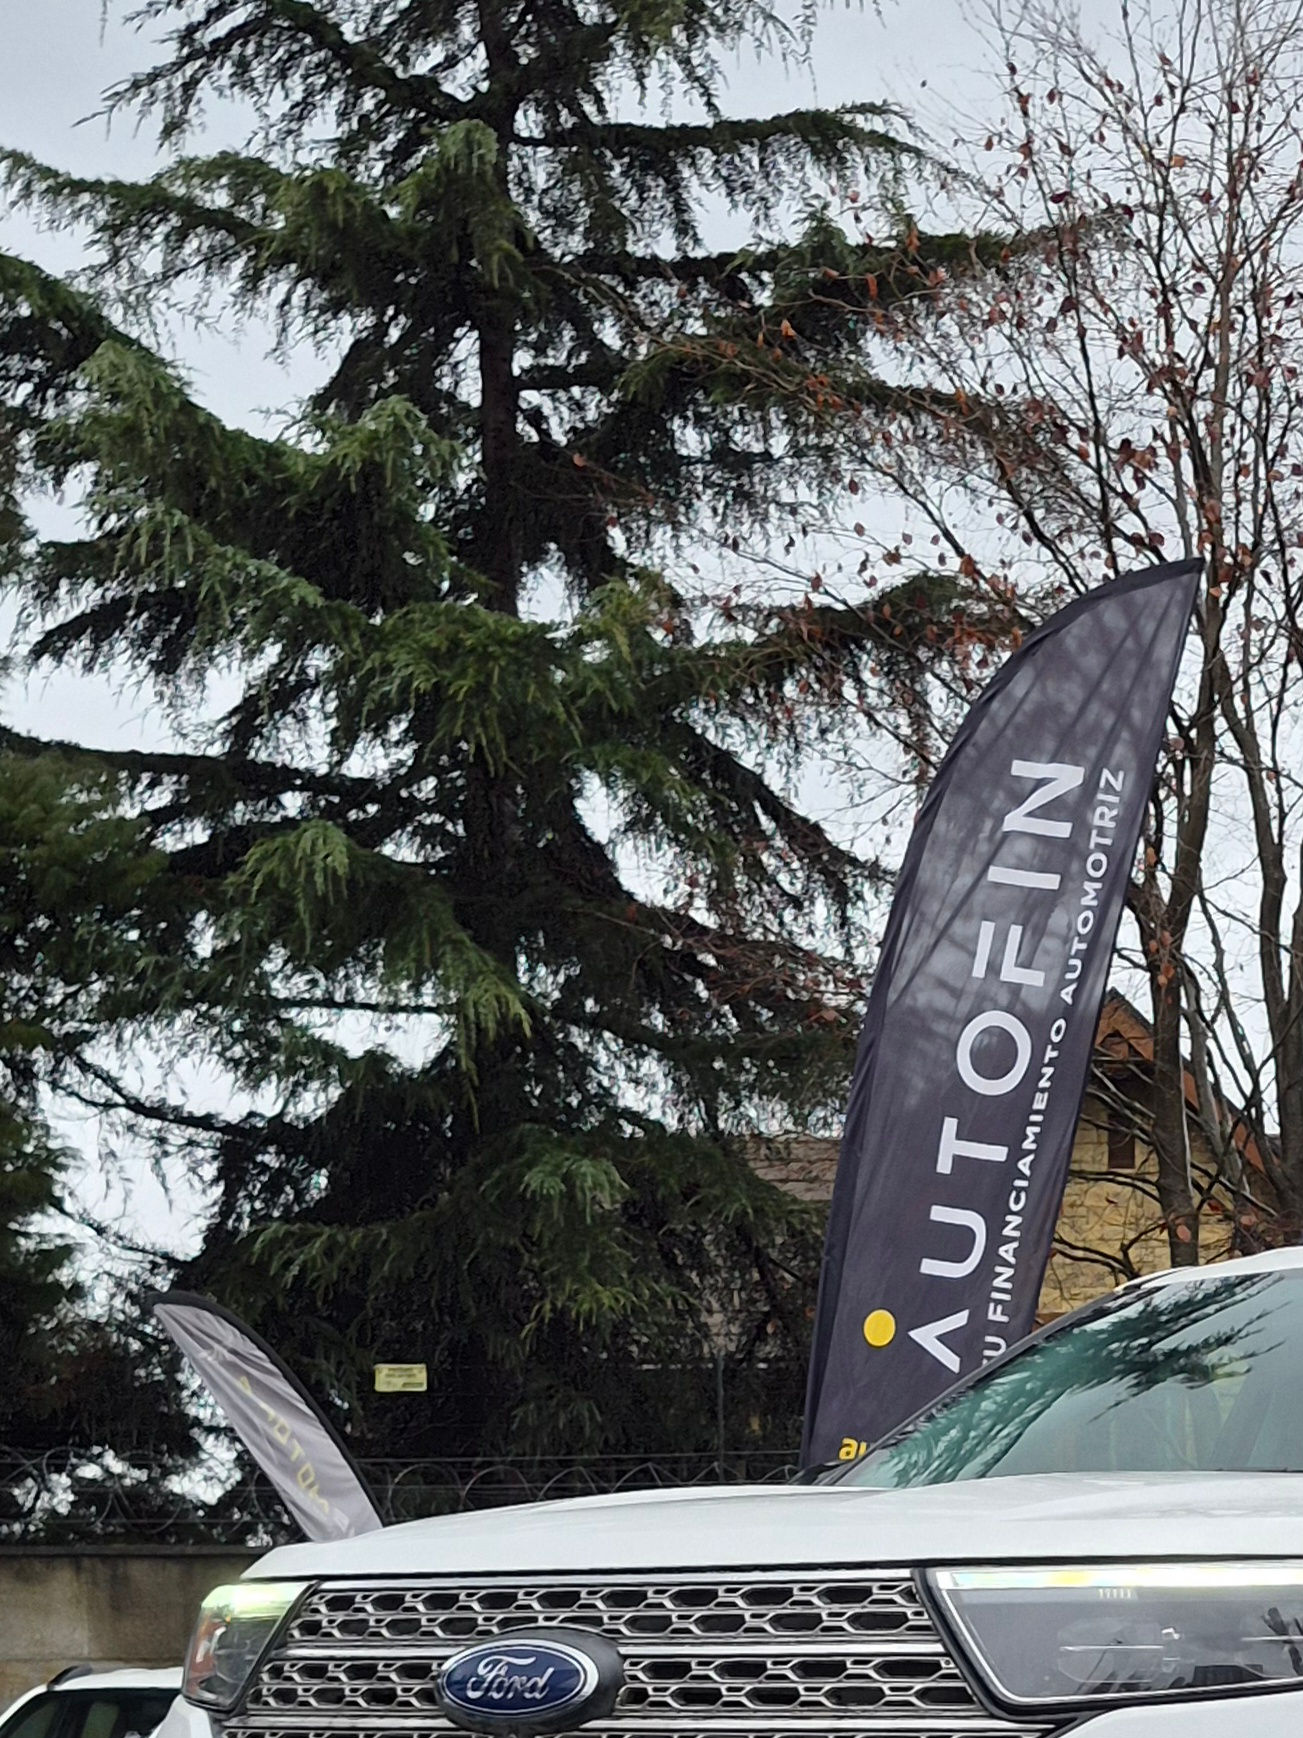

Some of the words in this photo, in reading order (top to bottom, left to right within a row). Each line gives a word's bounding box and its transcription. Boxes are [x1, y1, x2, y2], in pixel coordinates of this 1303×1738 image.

[1061, 766, 1126, 1006] AUTOMOTRIZ
[907, 759, 1085, 1375] AUTOFIN
[987, 1017, 1068, 1323] FINANCIAMIENTO
[982, 1335, 1007, 1367] U
[466, 1654, 555, 1700] Ford
